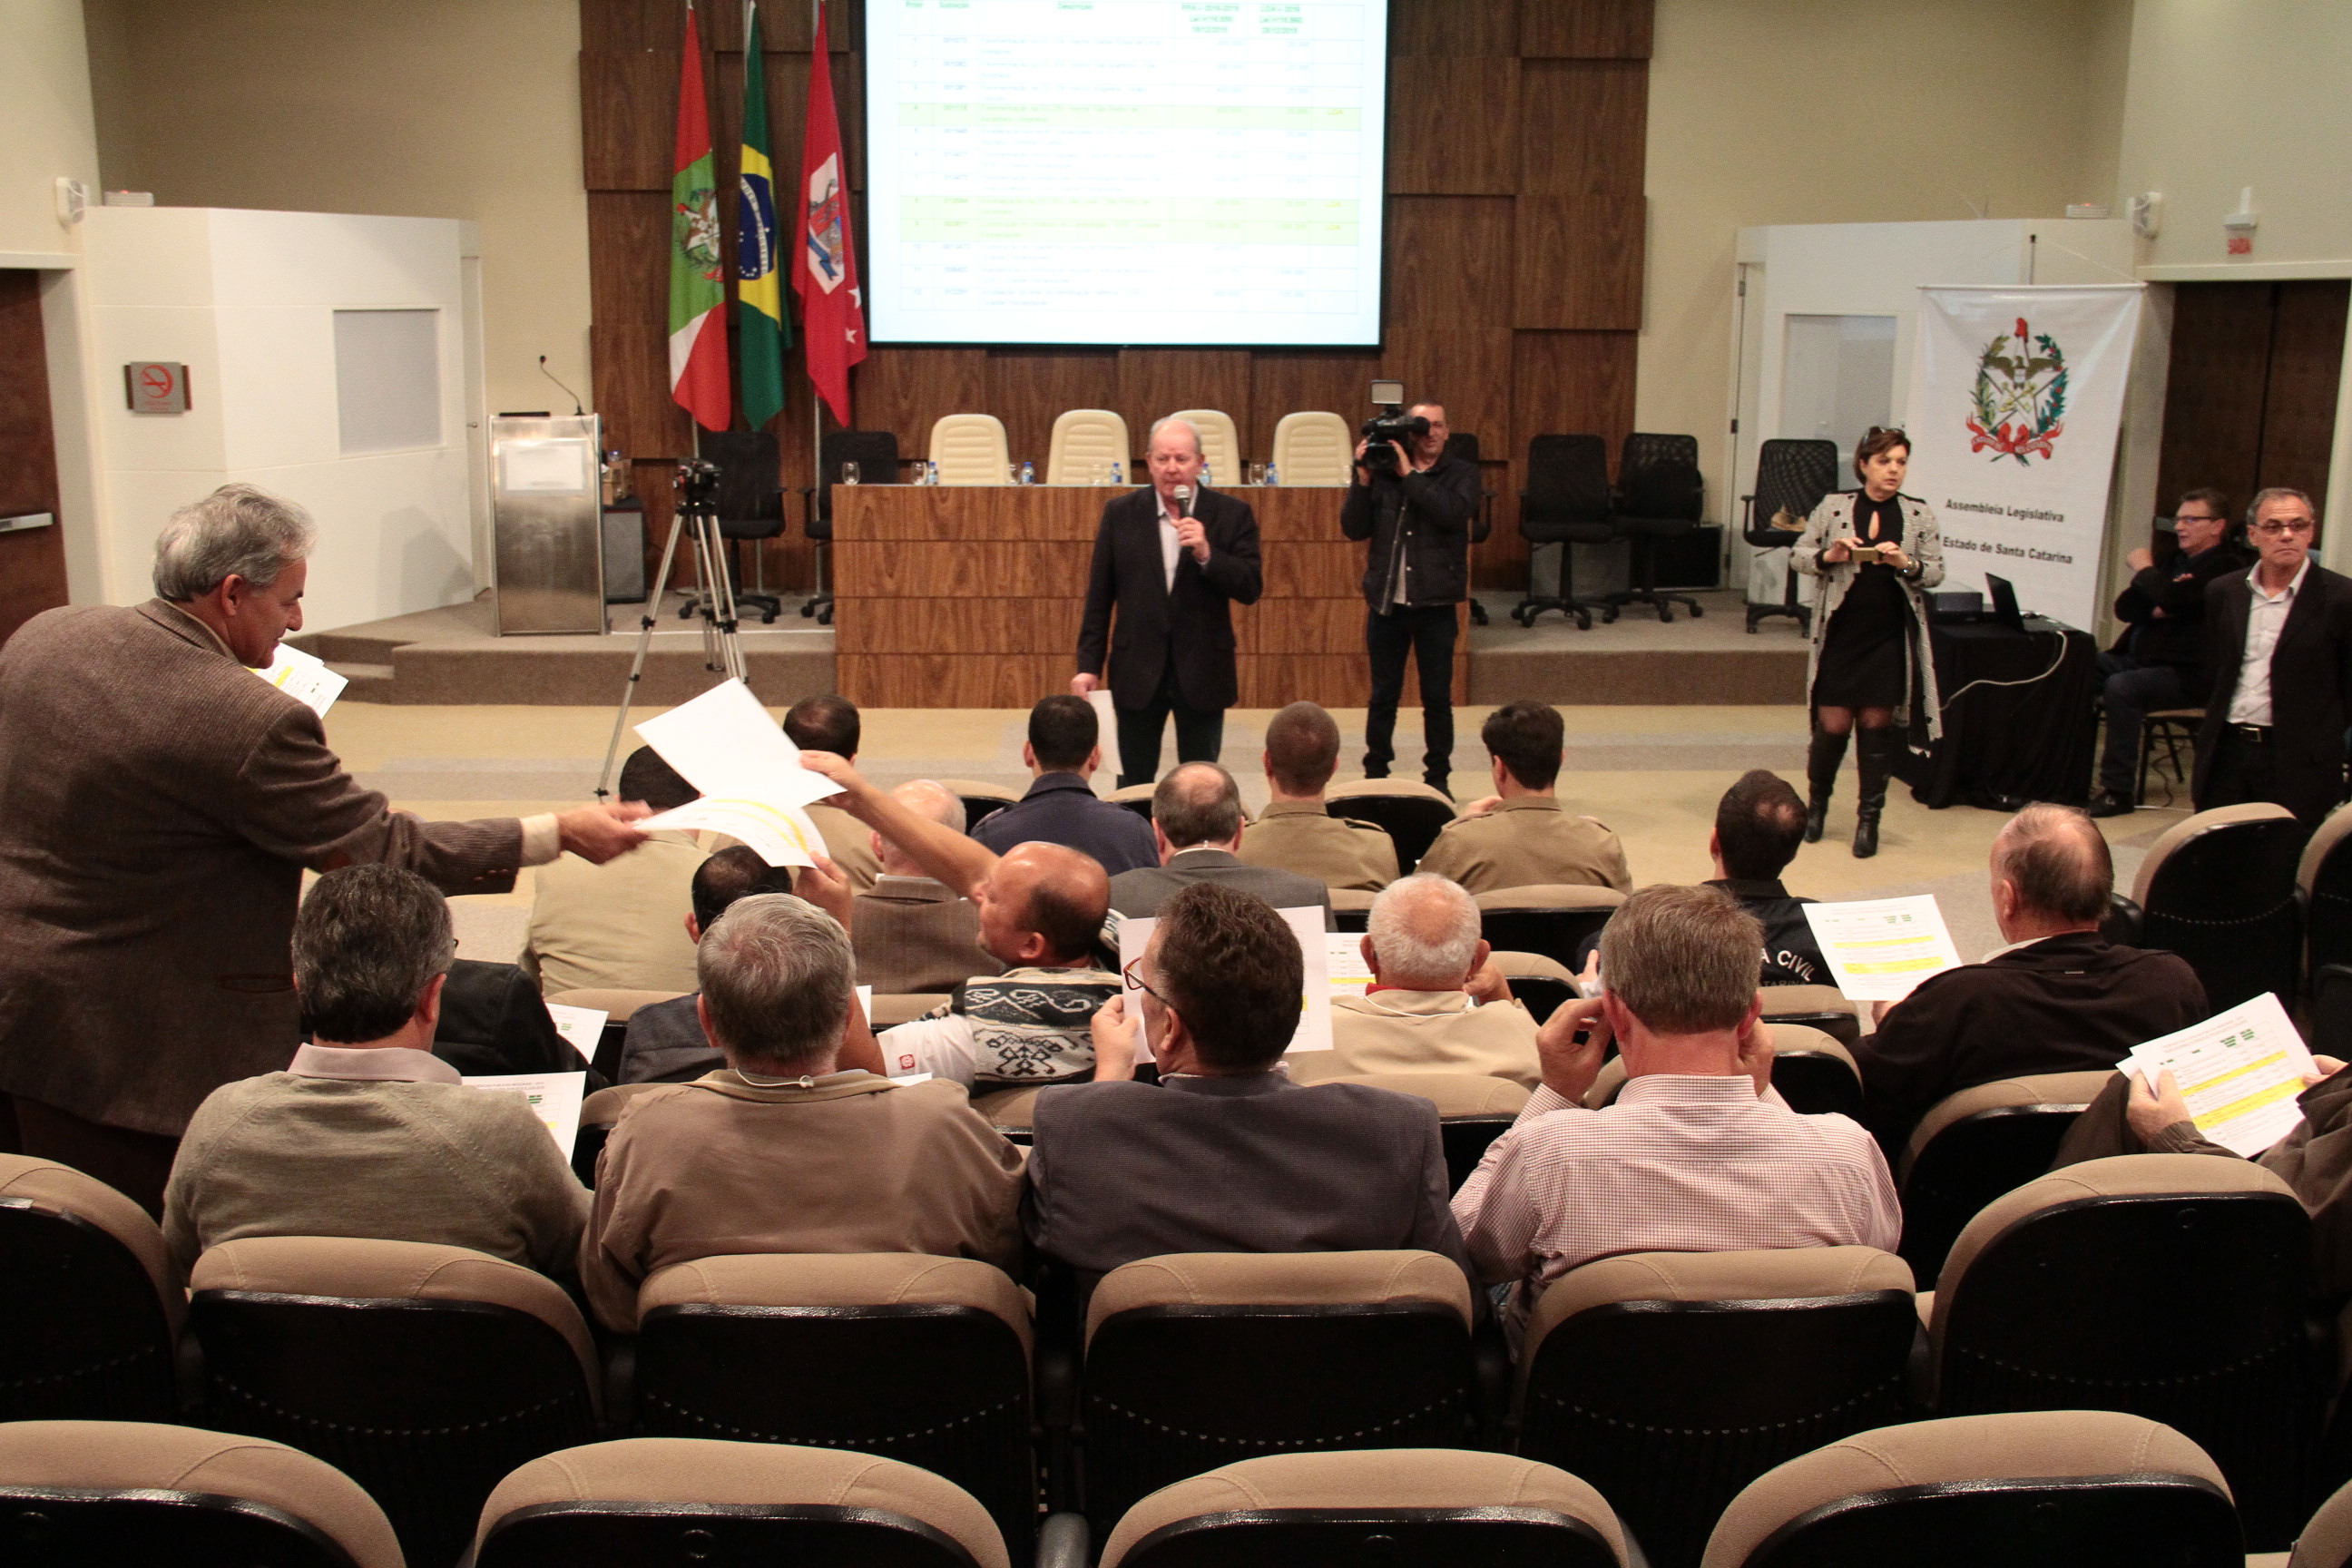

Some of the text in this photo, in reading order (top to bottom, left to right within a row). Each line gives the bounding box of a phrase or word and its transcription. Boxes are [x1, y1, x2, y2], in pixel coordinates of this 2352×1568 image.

[1945, 499, 2064, 523] Assembleia Legislativa
[1943, 536, 2073, 564] Estado de Santa Catarina
[1777, 949, 1816, 982] CIVIL
